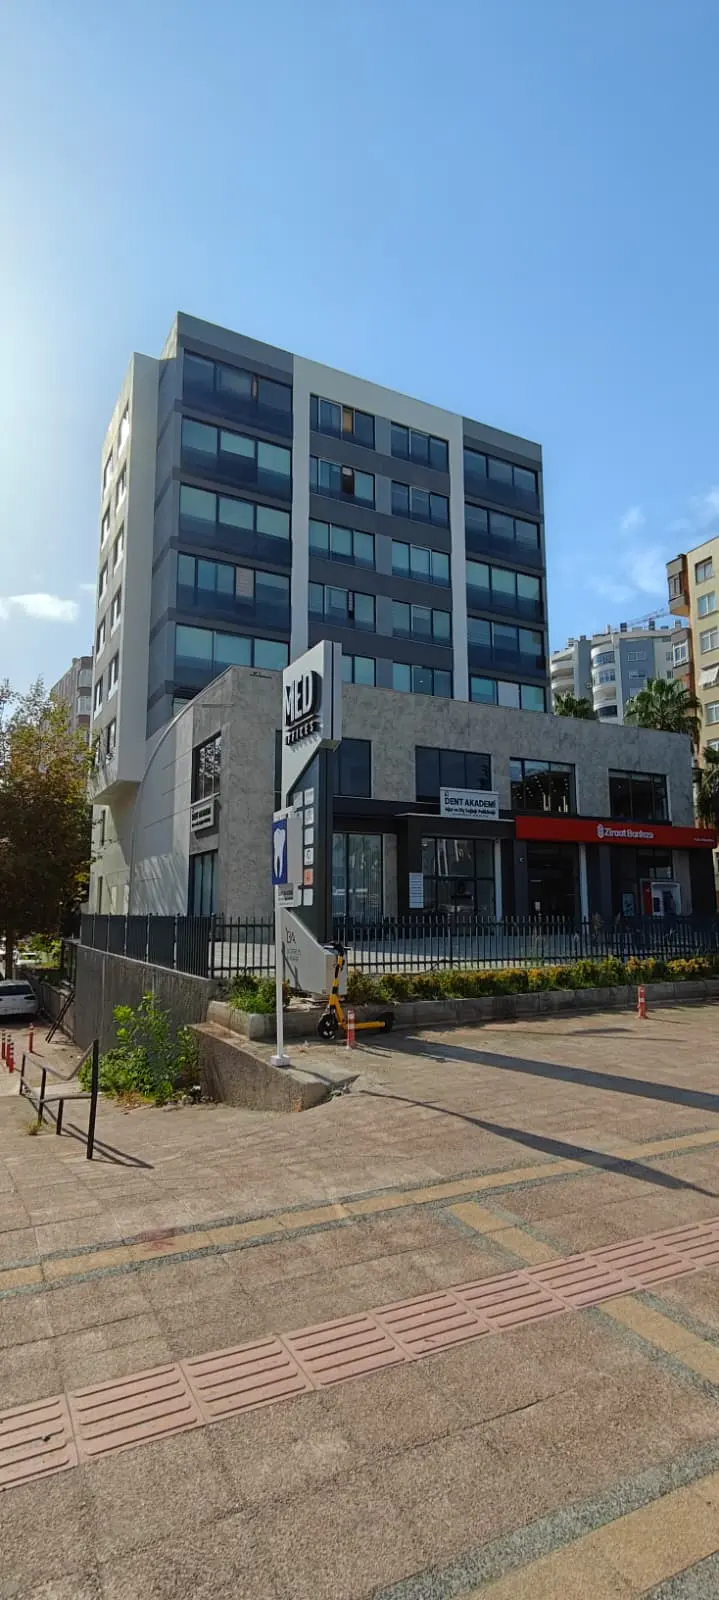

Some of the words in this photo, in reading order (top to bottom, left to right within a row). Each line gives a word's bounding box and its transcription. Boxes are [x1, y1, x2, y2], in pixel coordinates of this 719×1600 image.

[285, 672, 314, 724] MED
[444, 797, 463, 805] DENT
[604, 828, 626, 837] Ziraat
